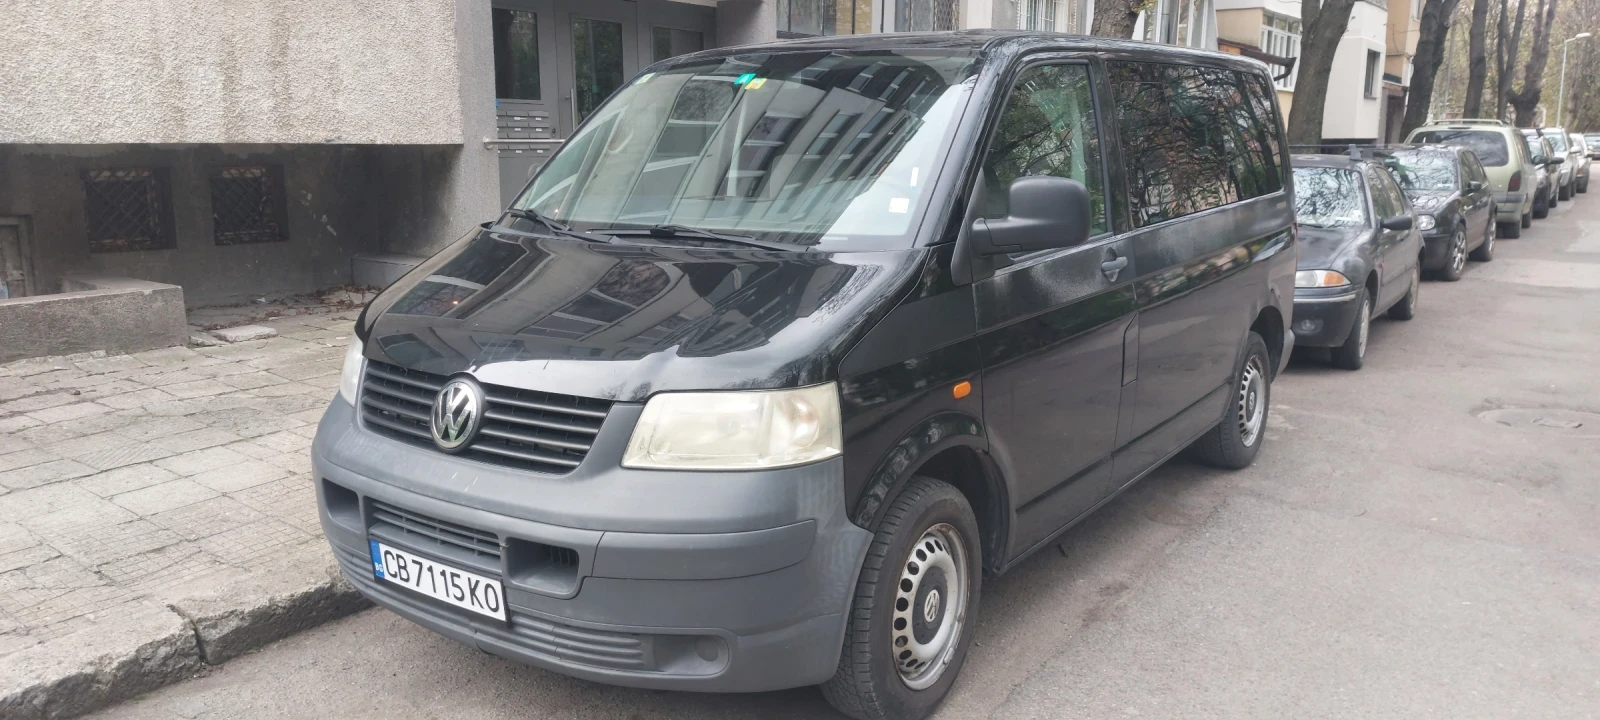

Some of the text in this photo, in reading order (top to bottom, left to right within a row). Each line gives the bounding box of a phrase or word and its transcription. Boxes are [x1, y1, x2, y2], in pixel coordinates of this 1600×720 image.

[432, 380, 477, 449] VW
[374, 549, 500, 613] BG CB7115KO
